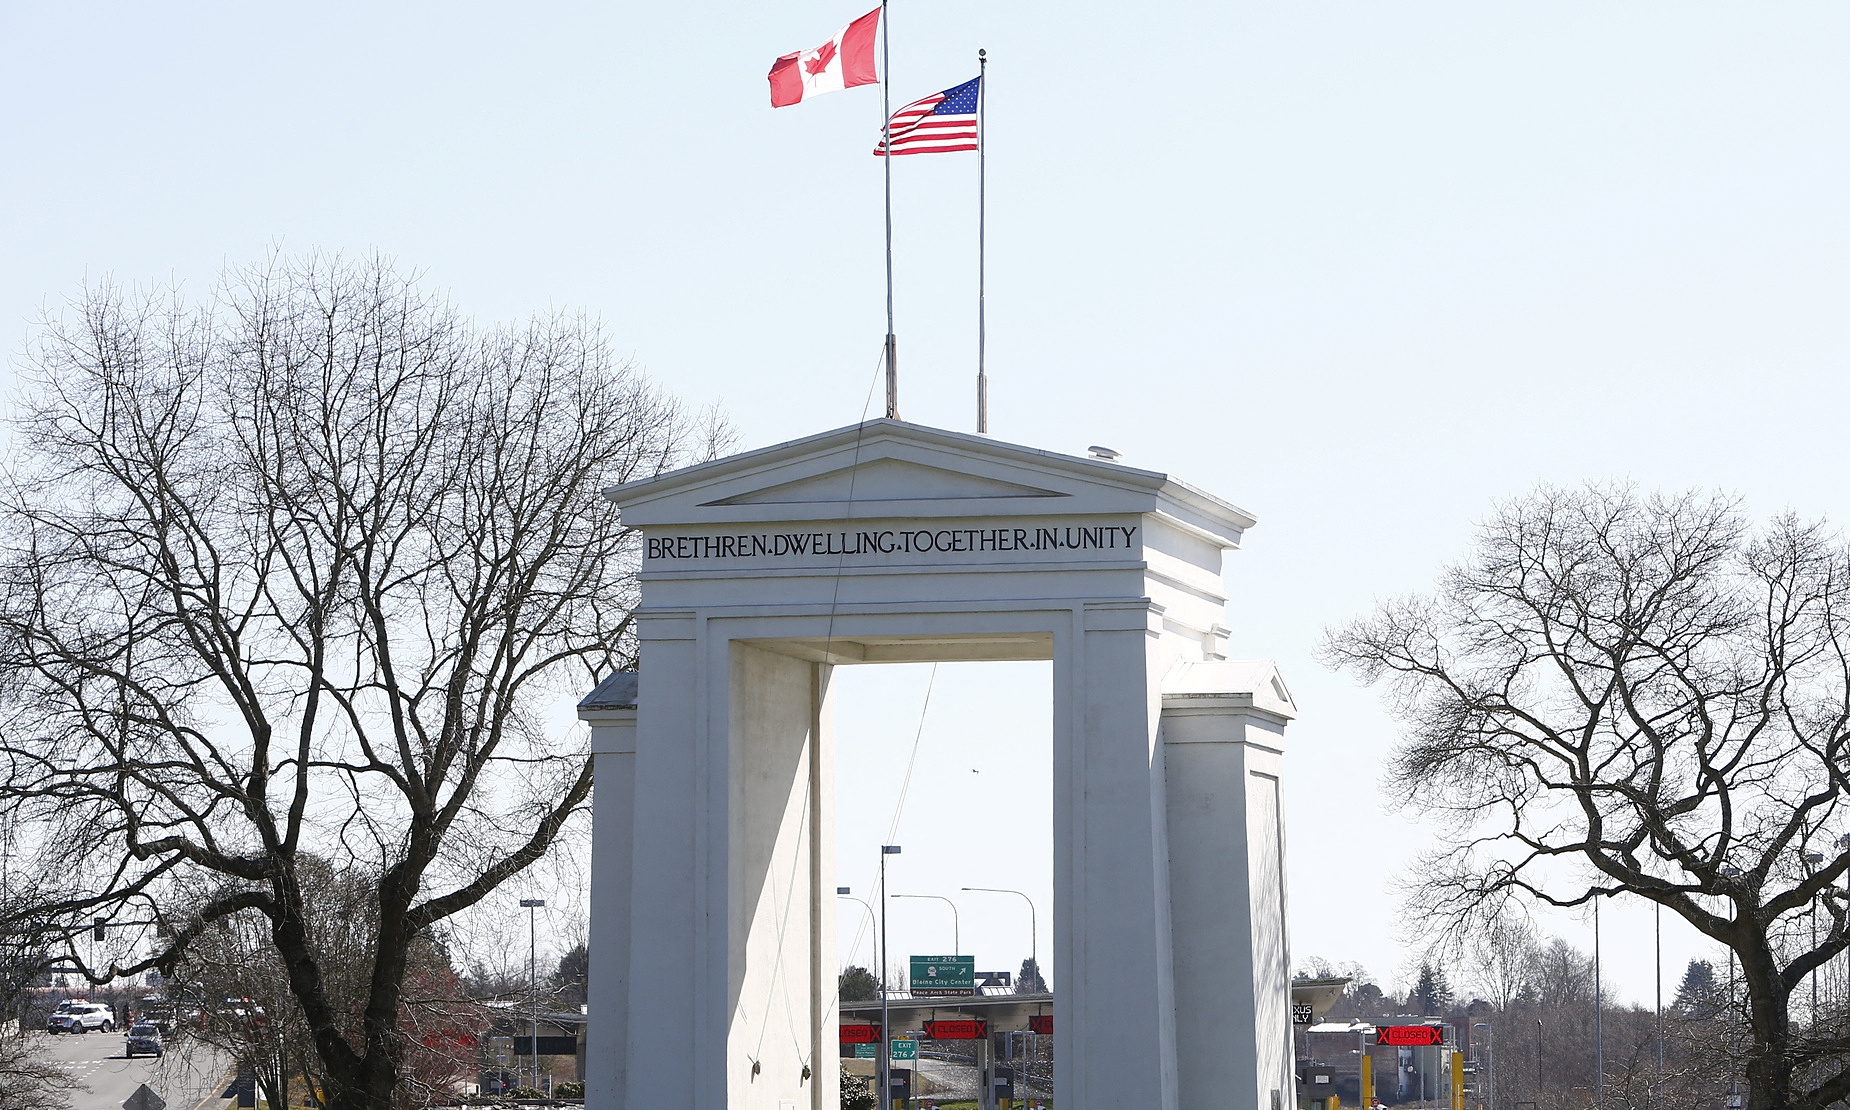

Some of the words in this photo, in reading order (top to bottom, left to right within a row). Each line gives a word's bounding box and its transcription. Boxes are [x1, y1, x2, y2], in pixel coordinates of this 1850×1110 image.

[648, 534, 767, 559] BRETHREN
[773, 531, 896, 556] DWELLING
[900, 528, 1029, 553] TOGETHER
[1035, 528, 1058, 550] IN
[1065, 526, 1137, 549] UNITY
[1293, 1006, 1312, 1014] XUS
[937, 1025, 973, 1033] CLOSED
[1392, 1030, 1428, 1039] CLOSED
